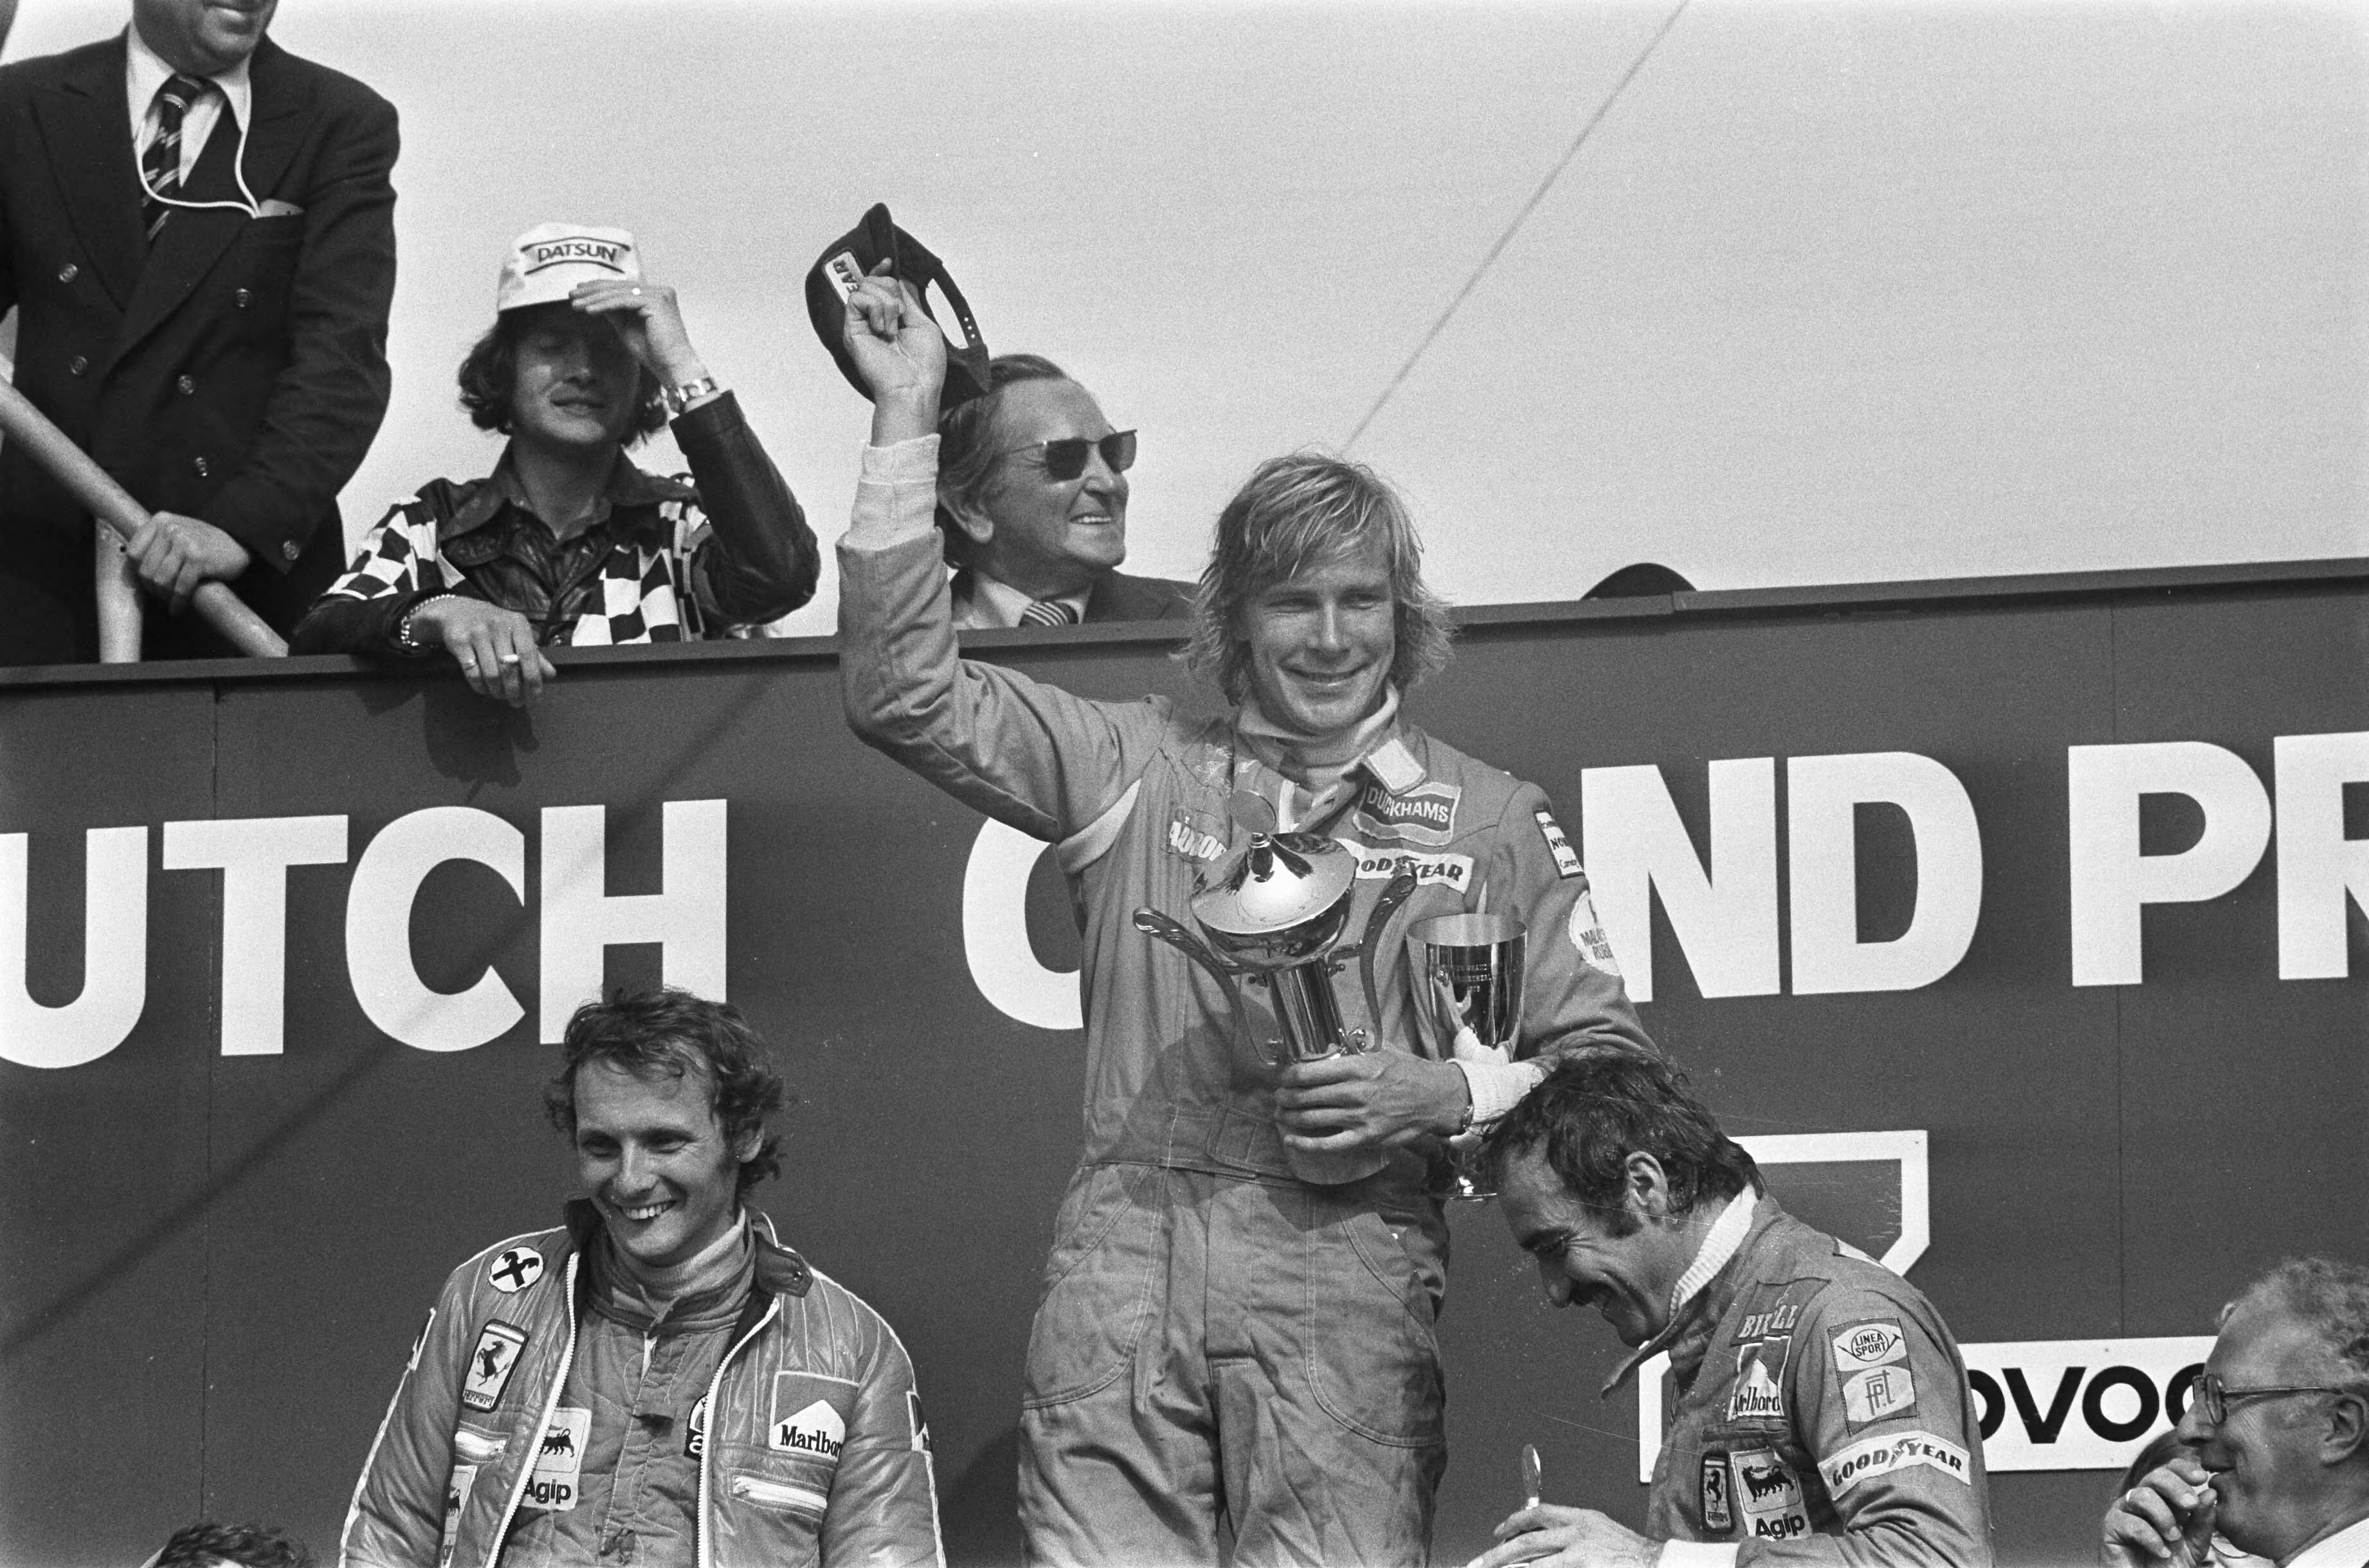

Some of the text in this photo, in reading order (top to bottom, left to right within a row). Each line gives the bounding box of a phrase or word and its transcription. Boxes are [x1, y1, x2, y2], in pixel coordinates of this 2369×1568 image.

[538, 243, 617, 263] DATSUN
[1366, 786, 1449, 823] DUCKHAMS
[1354, 856, 1464, 882] ODYEAR
[0, 732, 2369, 1069] UTCH GND PR
[1855, 1332, 1884, 1346] LINEA
[1855, 1343, 1887, 1358] SPORT
[780, 1424, 844, 1457] Marlbor
[1833, 1440, 1962, 1486] GOODYEAR
[523, 1475, 572, 1505] Agip
[1756, 1513, 1806, 1540] Agip
